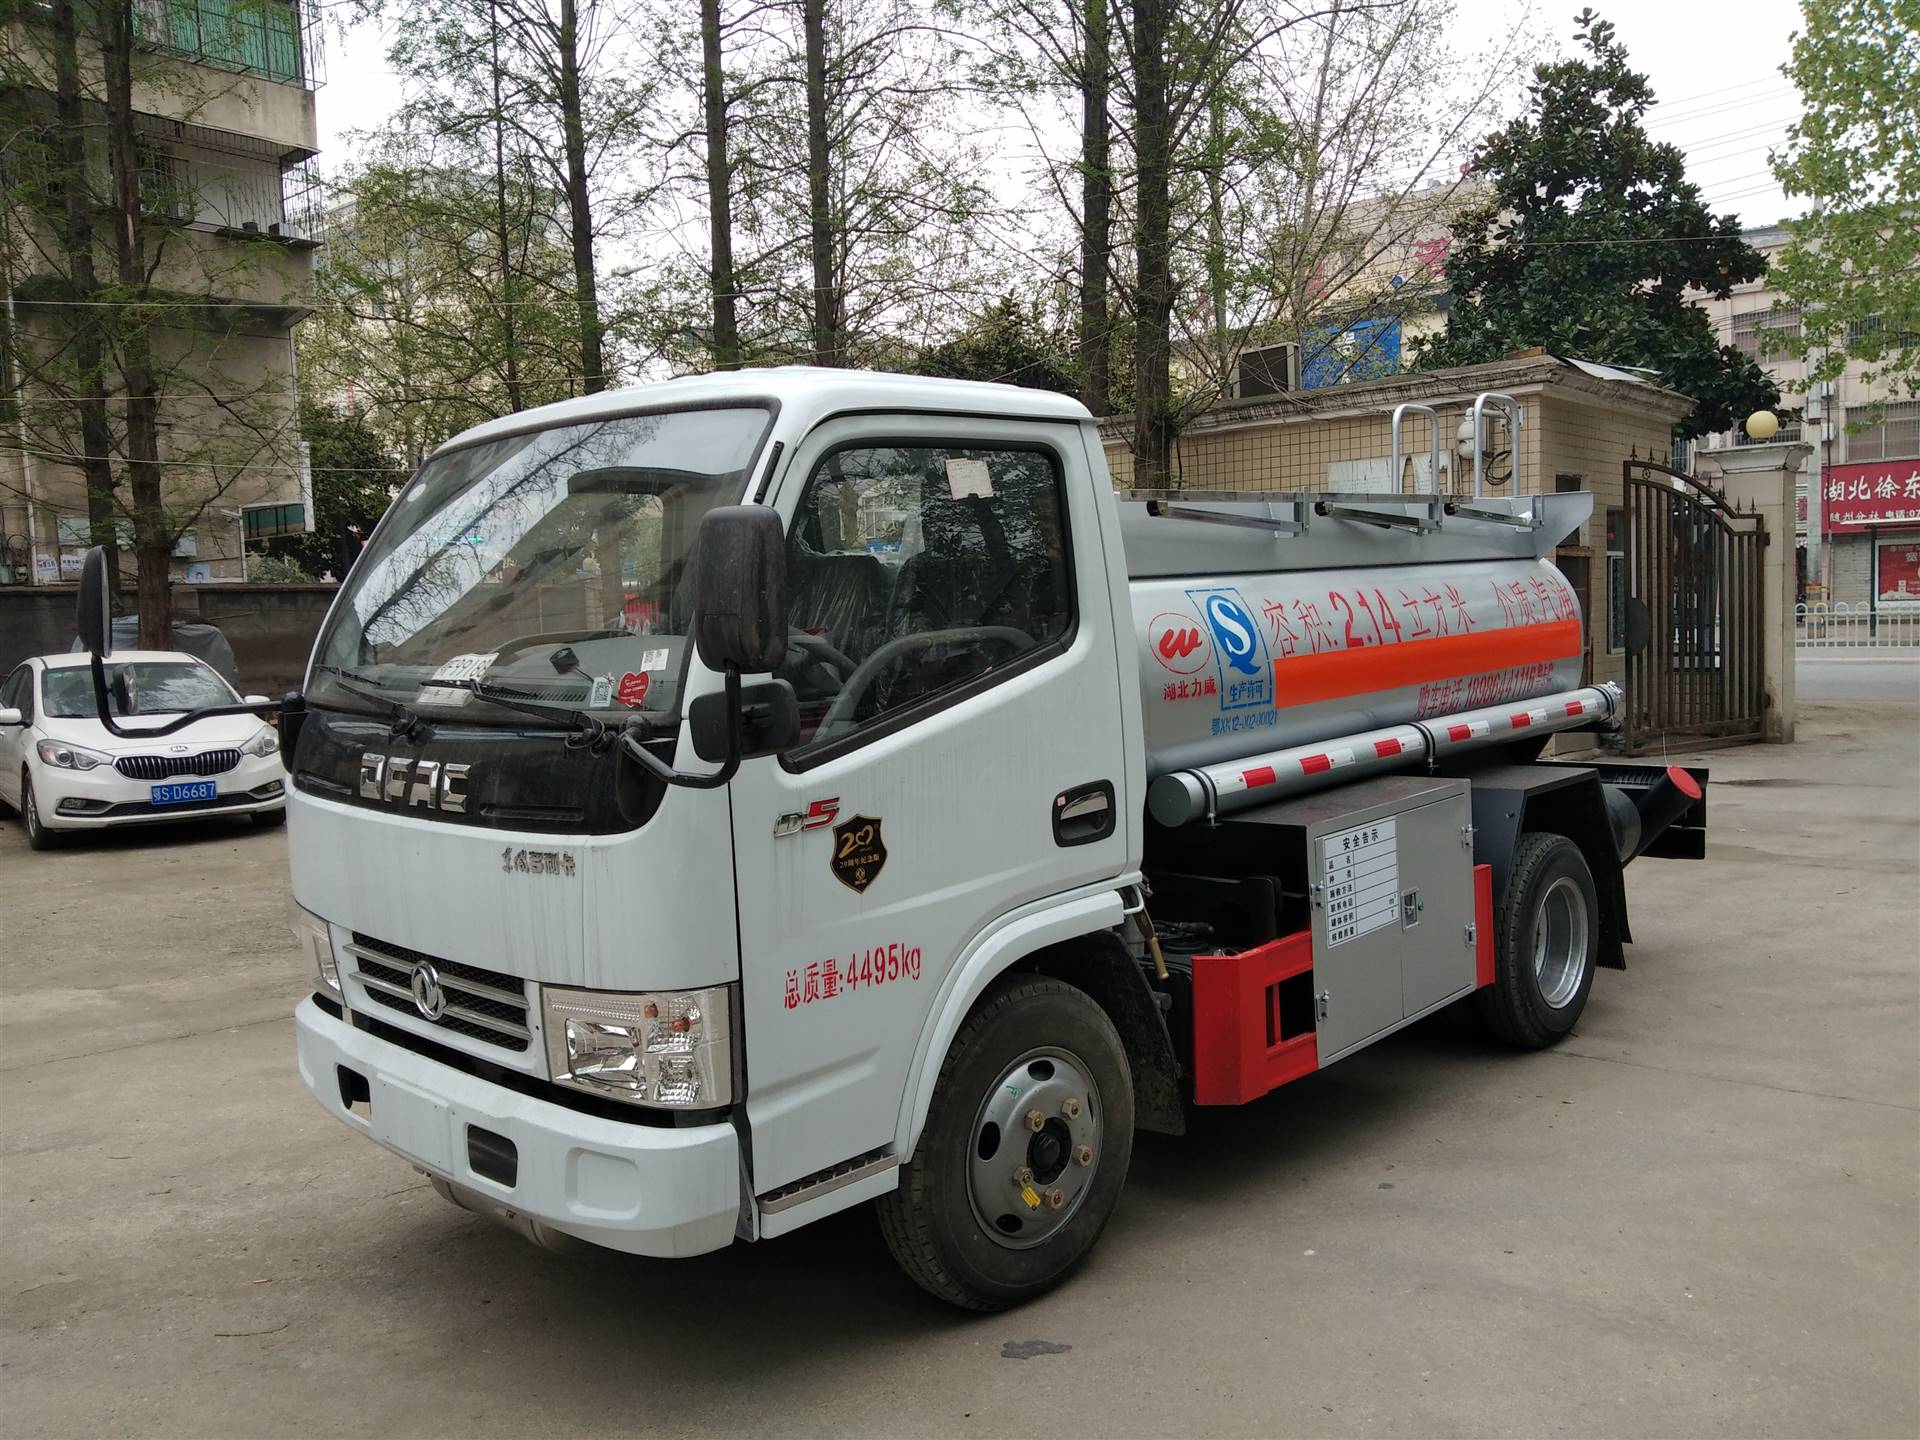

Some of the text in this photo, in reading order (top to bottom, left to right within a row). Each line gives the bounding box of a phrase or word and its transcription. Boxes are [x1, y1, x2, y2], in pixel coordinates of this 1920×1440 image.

[1824, 470, 1920, 501] 湖北徐东
[1229, 679, 1264, 702] 生产许可
[1342, 828, 1379, 851] 安全告示
[783, 942, 922, 1010] 总质量:4495kg
